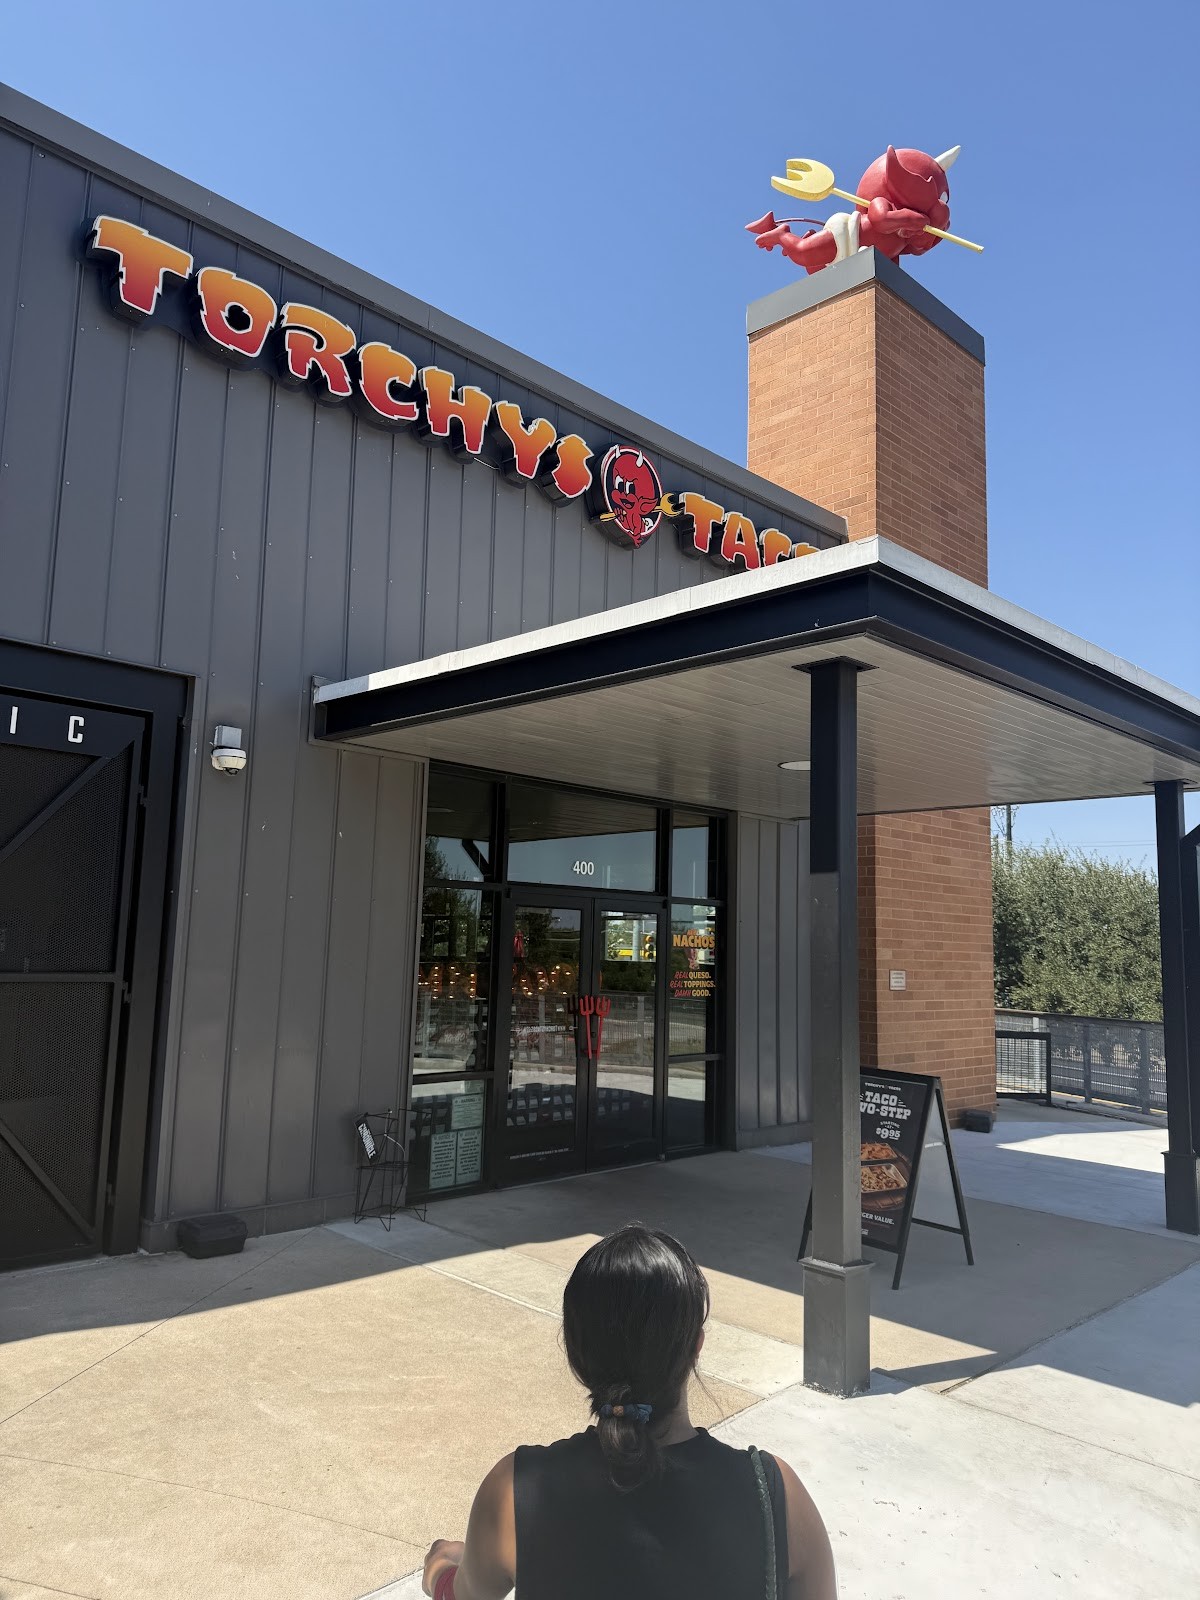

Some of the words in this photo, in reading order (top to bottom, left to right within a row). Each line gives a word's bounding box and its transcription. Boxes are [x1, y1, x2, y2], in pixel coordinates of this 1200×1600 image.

[91, 214, 595, 498] TORCHYS
[681, 491, 821, 571] TAC
[573, 860, 595, 876] 400
[673, 934, 715, 948] NACHOS
[865, 1091, 898, 1106] TACO
[874, 1215, 894, 1224] VALUE.
